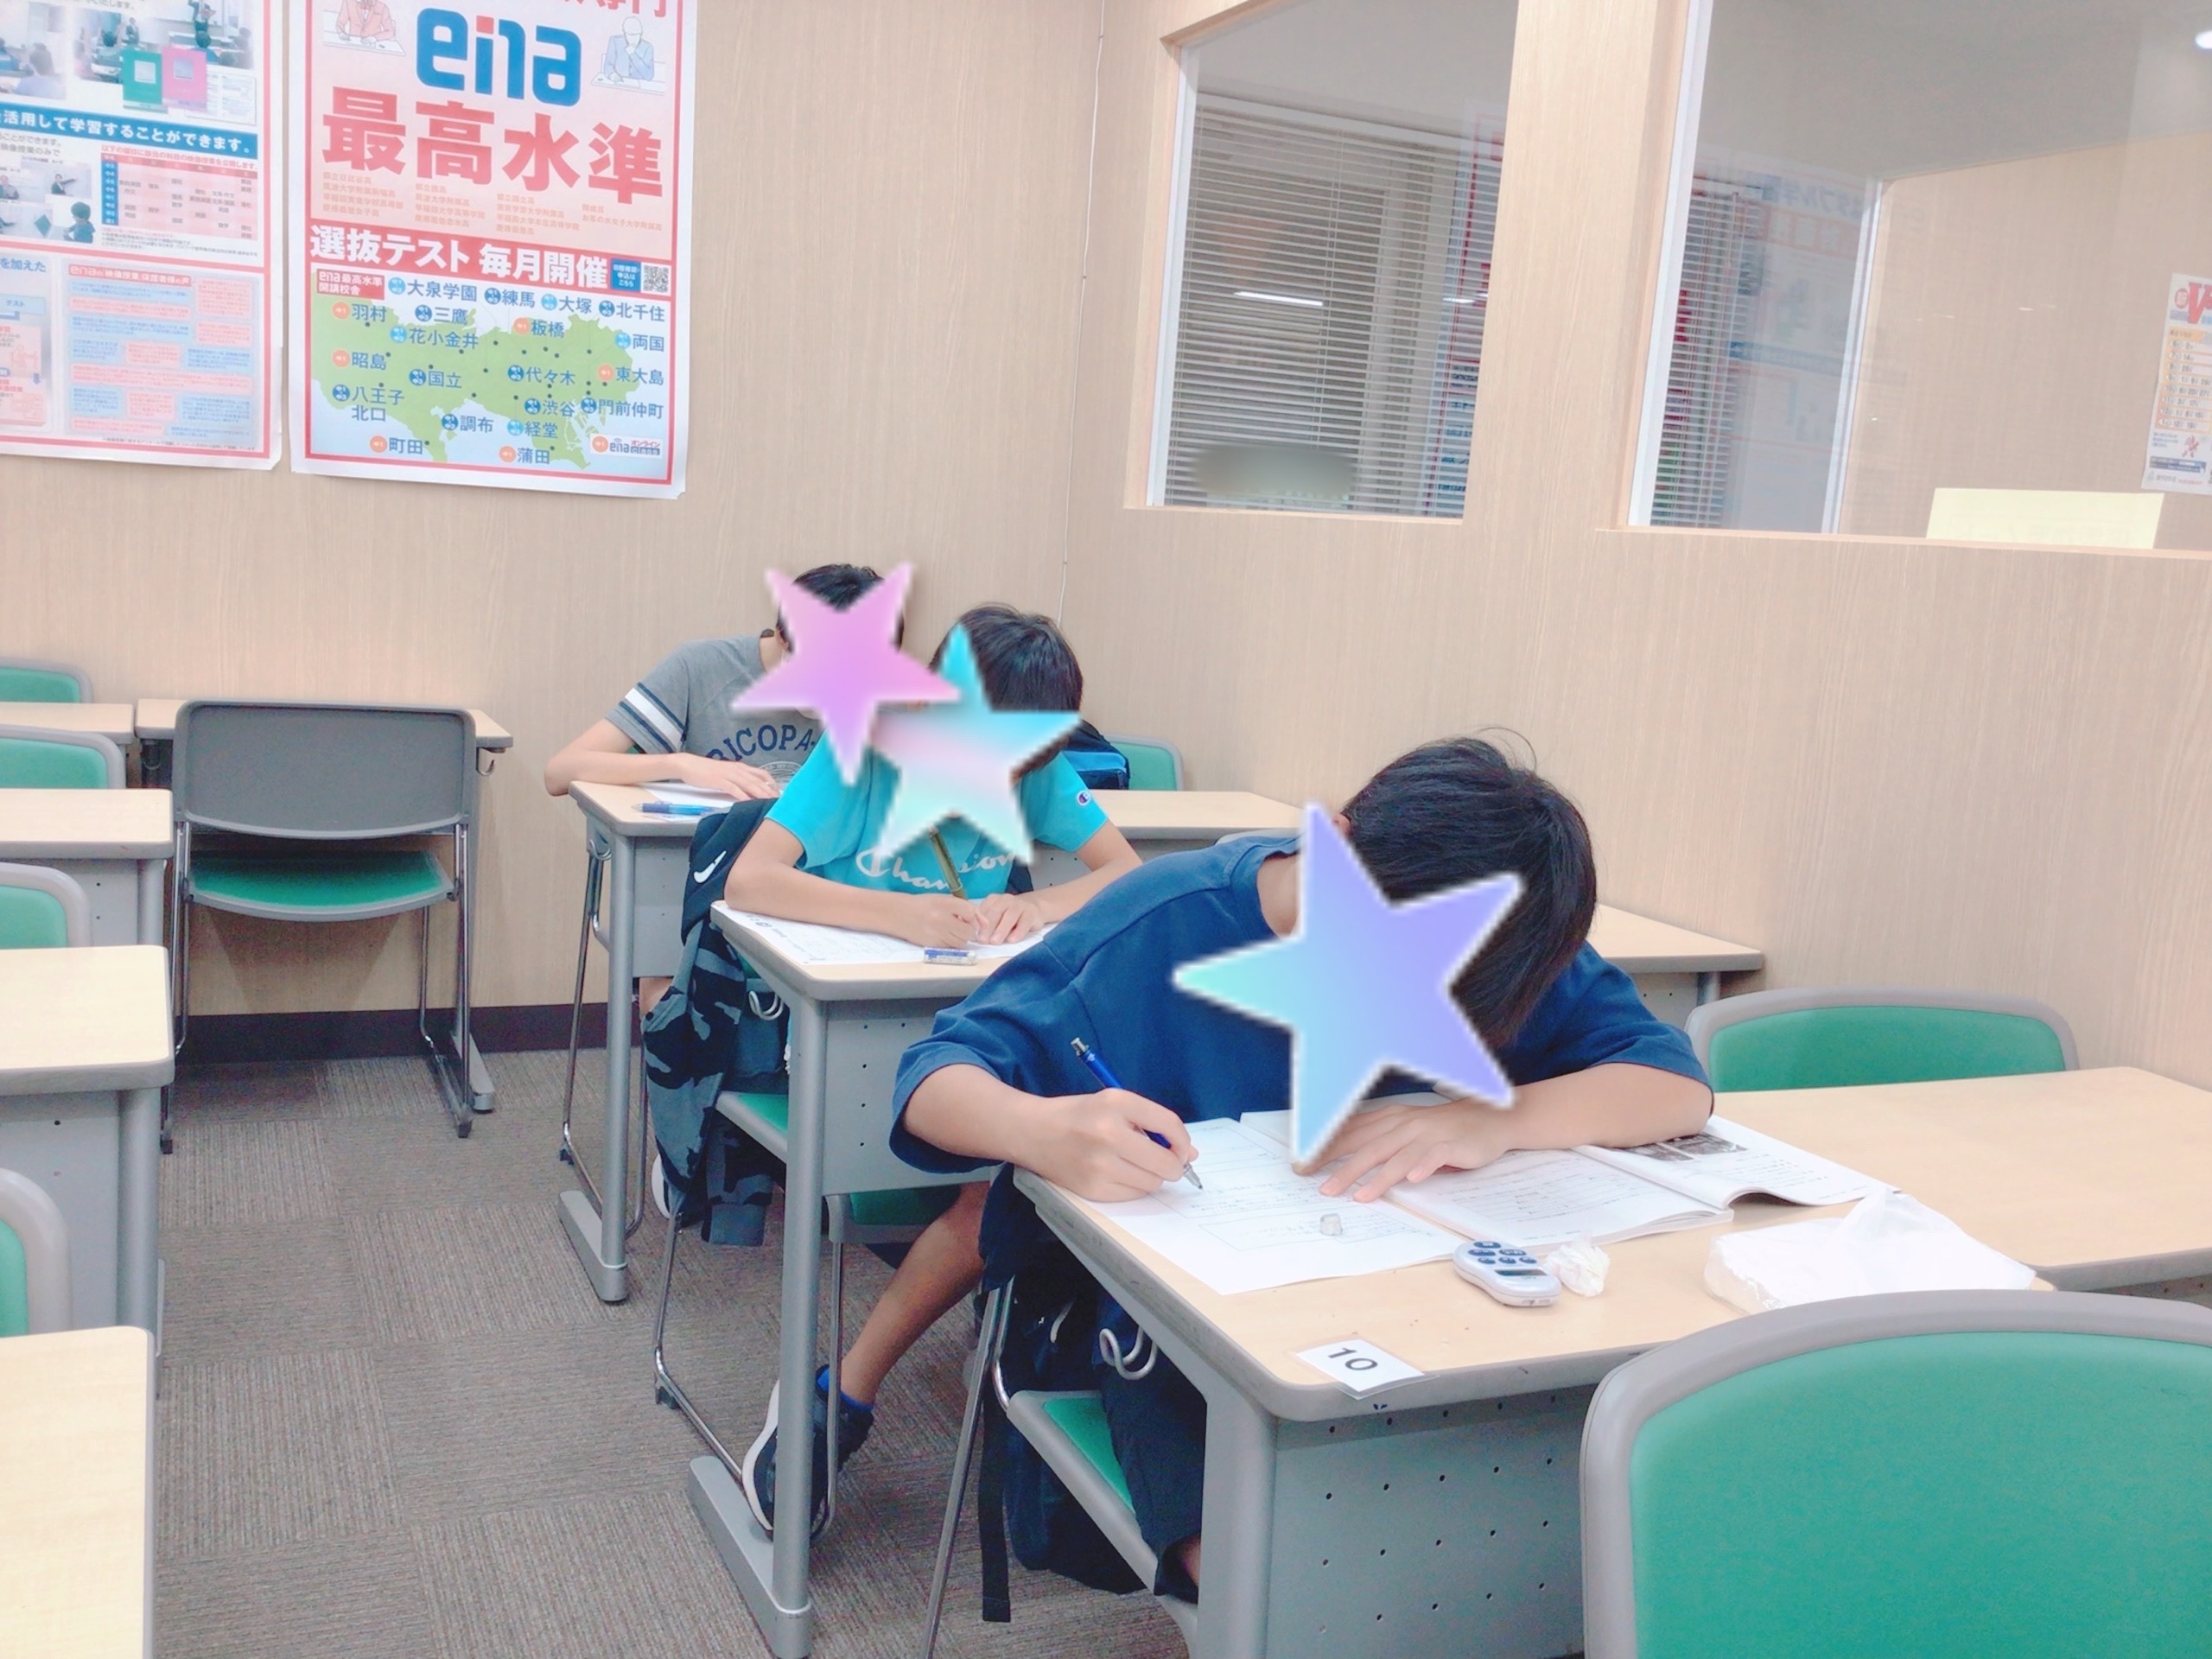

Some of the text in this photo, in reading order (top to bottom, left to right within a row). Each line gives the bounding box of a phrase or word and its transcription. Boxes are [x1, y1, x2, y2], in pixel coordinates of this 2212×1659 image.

[322, 86, 663, 205] 最高水準
[309, 224, 471, 275] 選抜テスト
[479, 243, 608, 289] 毎月開催
[407, 279, 477, 302] 大泉学園
[501, 289, 536, 308] 練馬
[351, 303, 387, 322] 羽村
[558, 295, 593, 315] 大塚
[616, 302, 665, 322] 北千住
[434, 305, 469, 326] 三鷹
[531, 319, 565, 338] 板橋
[409, 327, 480, 350] 花小金井
[632, 334, 664, 353] 両国
[351, 352, 387, 371] 昭島
[428, 371, 462, 389] 国立
[525, 366, 576, 386] 代々木
[615, 366, 664, 386] 東大島
[352, 386, 405, 406] 八王子
[351, 404, 386, 423] 北口
[542, 399, 576, 418] 渋谷
[598, 399, 664, 420] 門前仲町
[460, 415, 494, 433] 調布
[524, 420, 558, 439] 経堂
[389, 437, 423, 455] 町田
[517, 448, 550, 465] 蒲田
[1327, 1347, 1378, 1371] 10
